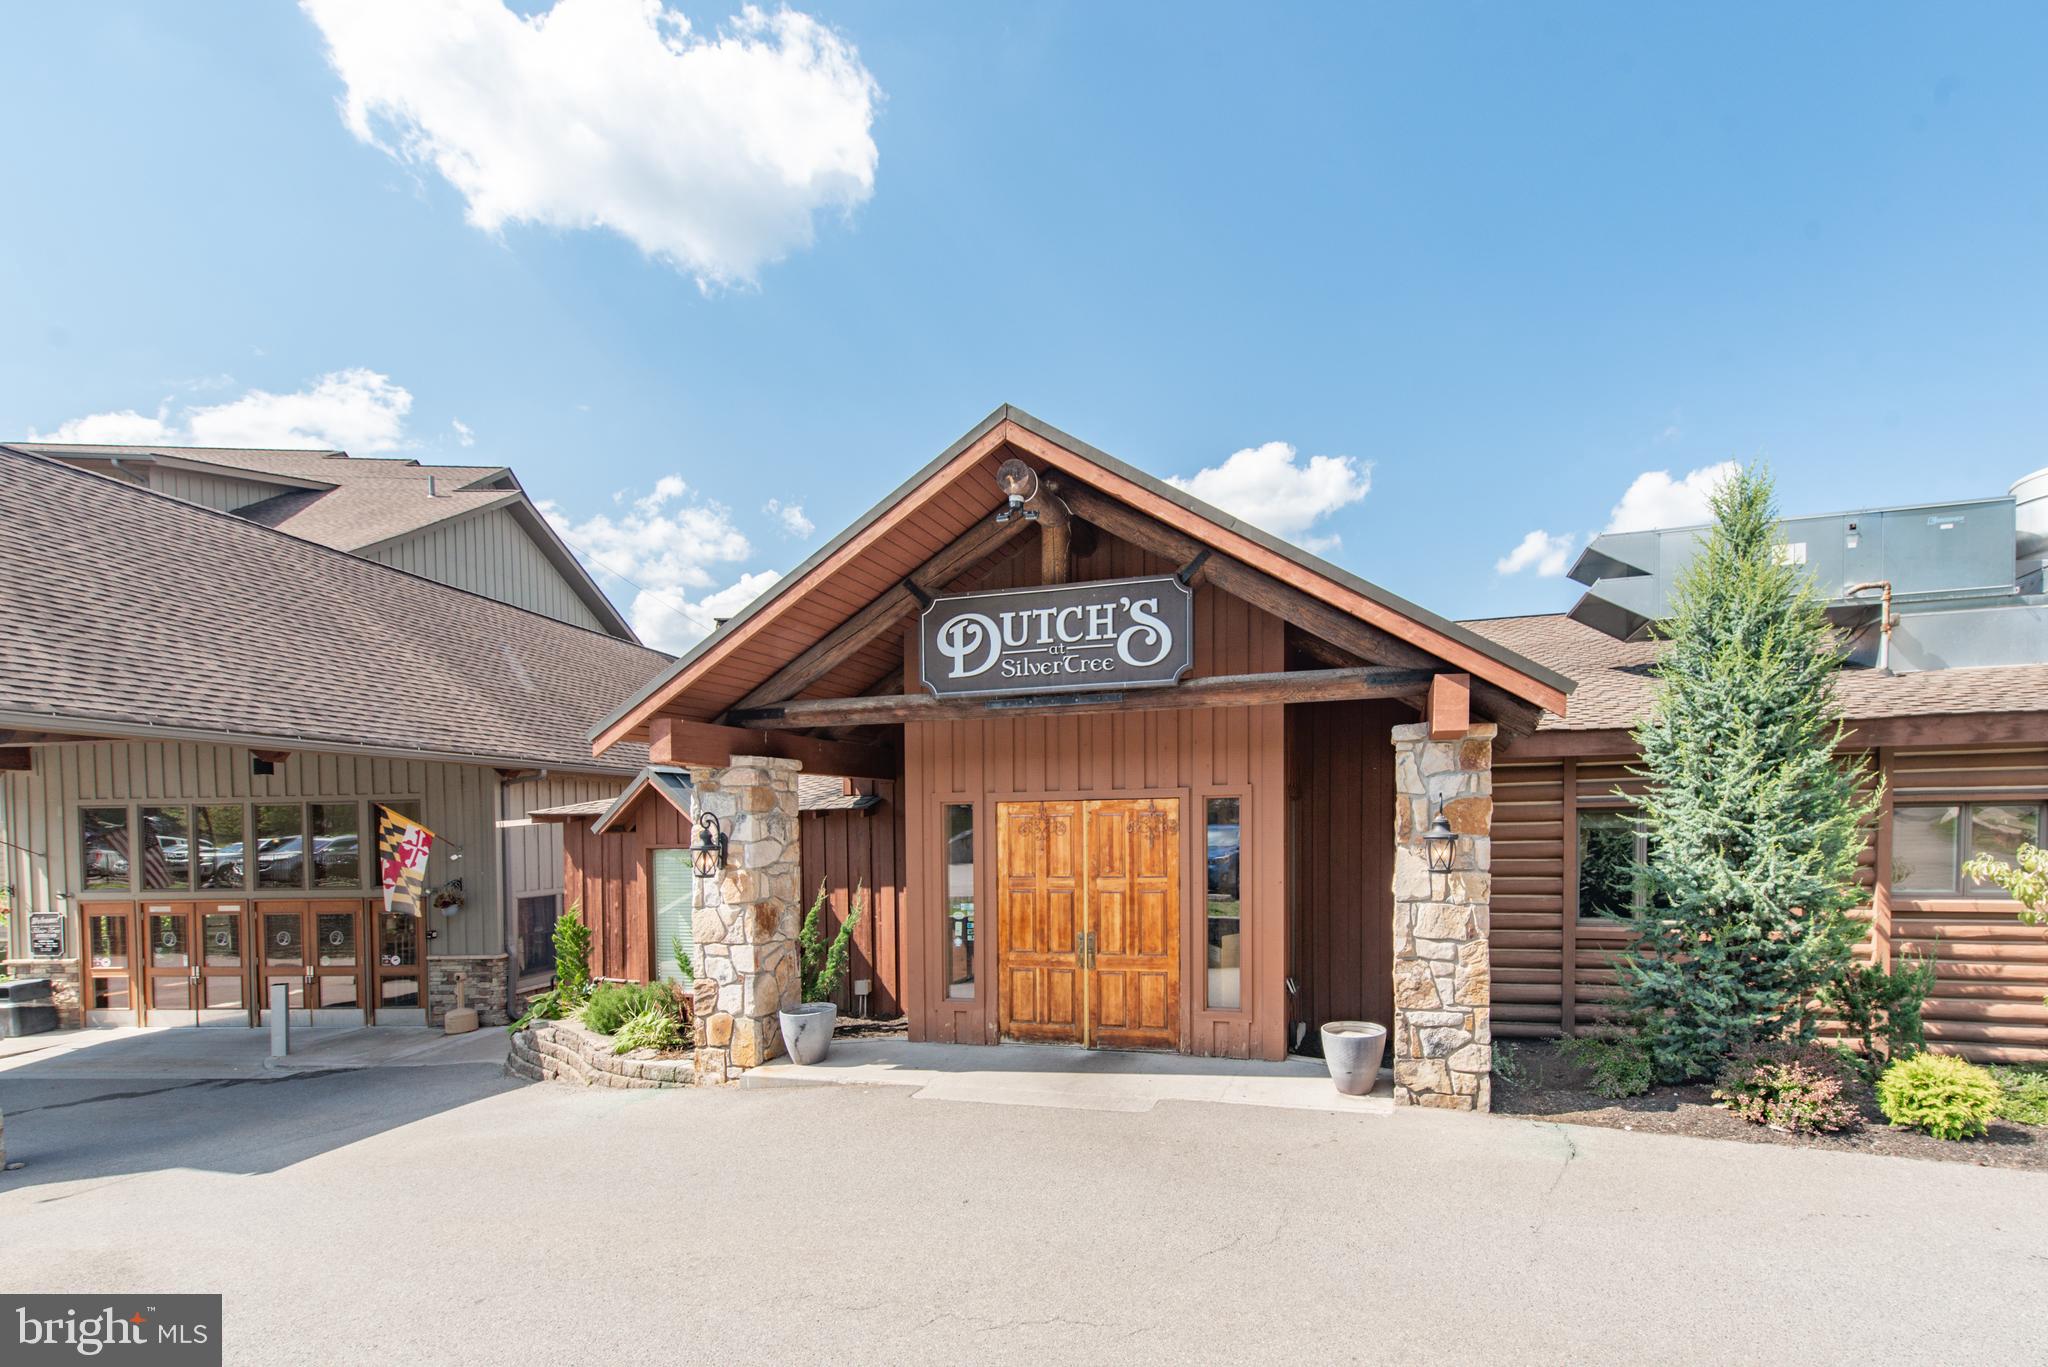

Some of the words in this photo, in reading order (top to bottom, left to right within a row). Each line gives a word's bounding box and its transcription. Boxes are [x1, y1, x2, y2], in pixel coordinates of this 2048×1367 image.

[936, 596, 1173, 679] DUTCH'S
[1048, 642, 1065, 655] at
[1000, 653, 1115, 678] SilverTree
